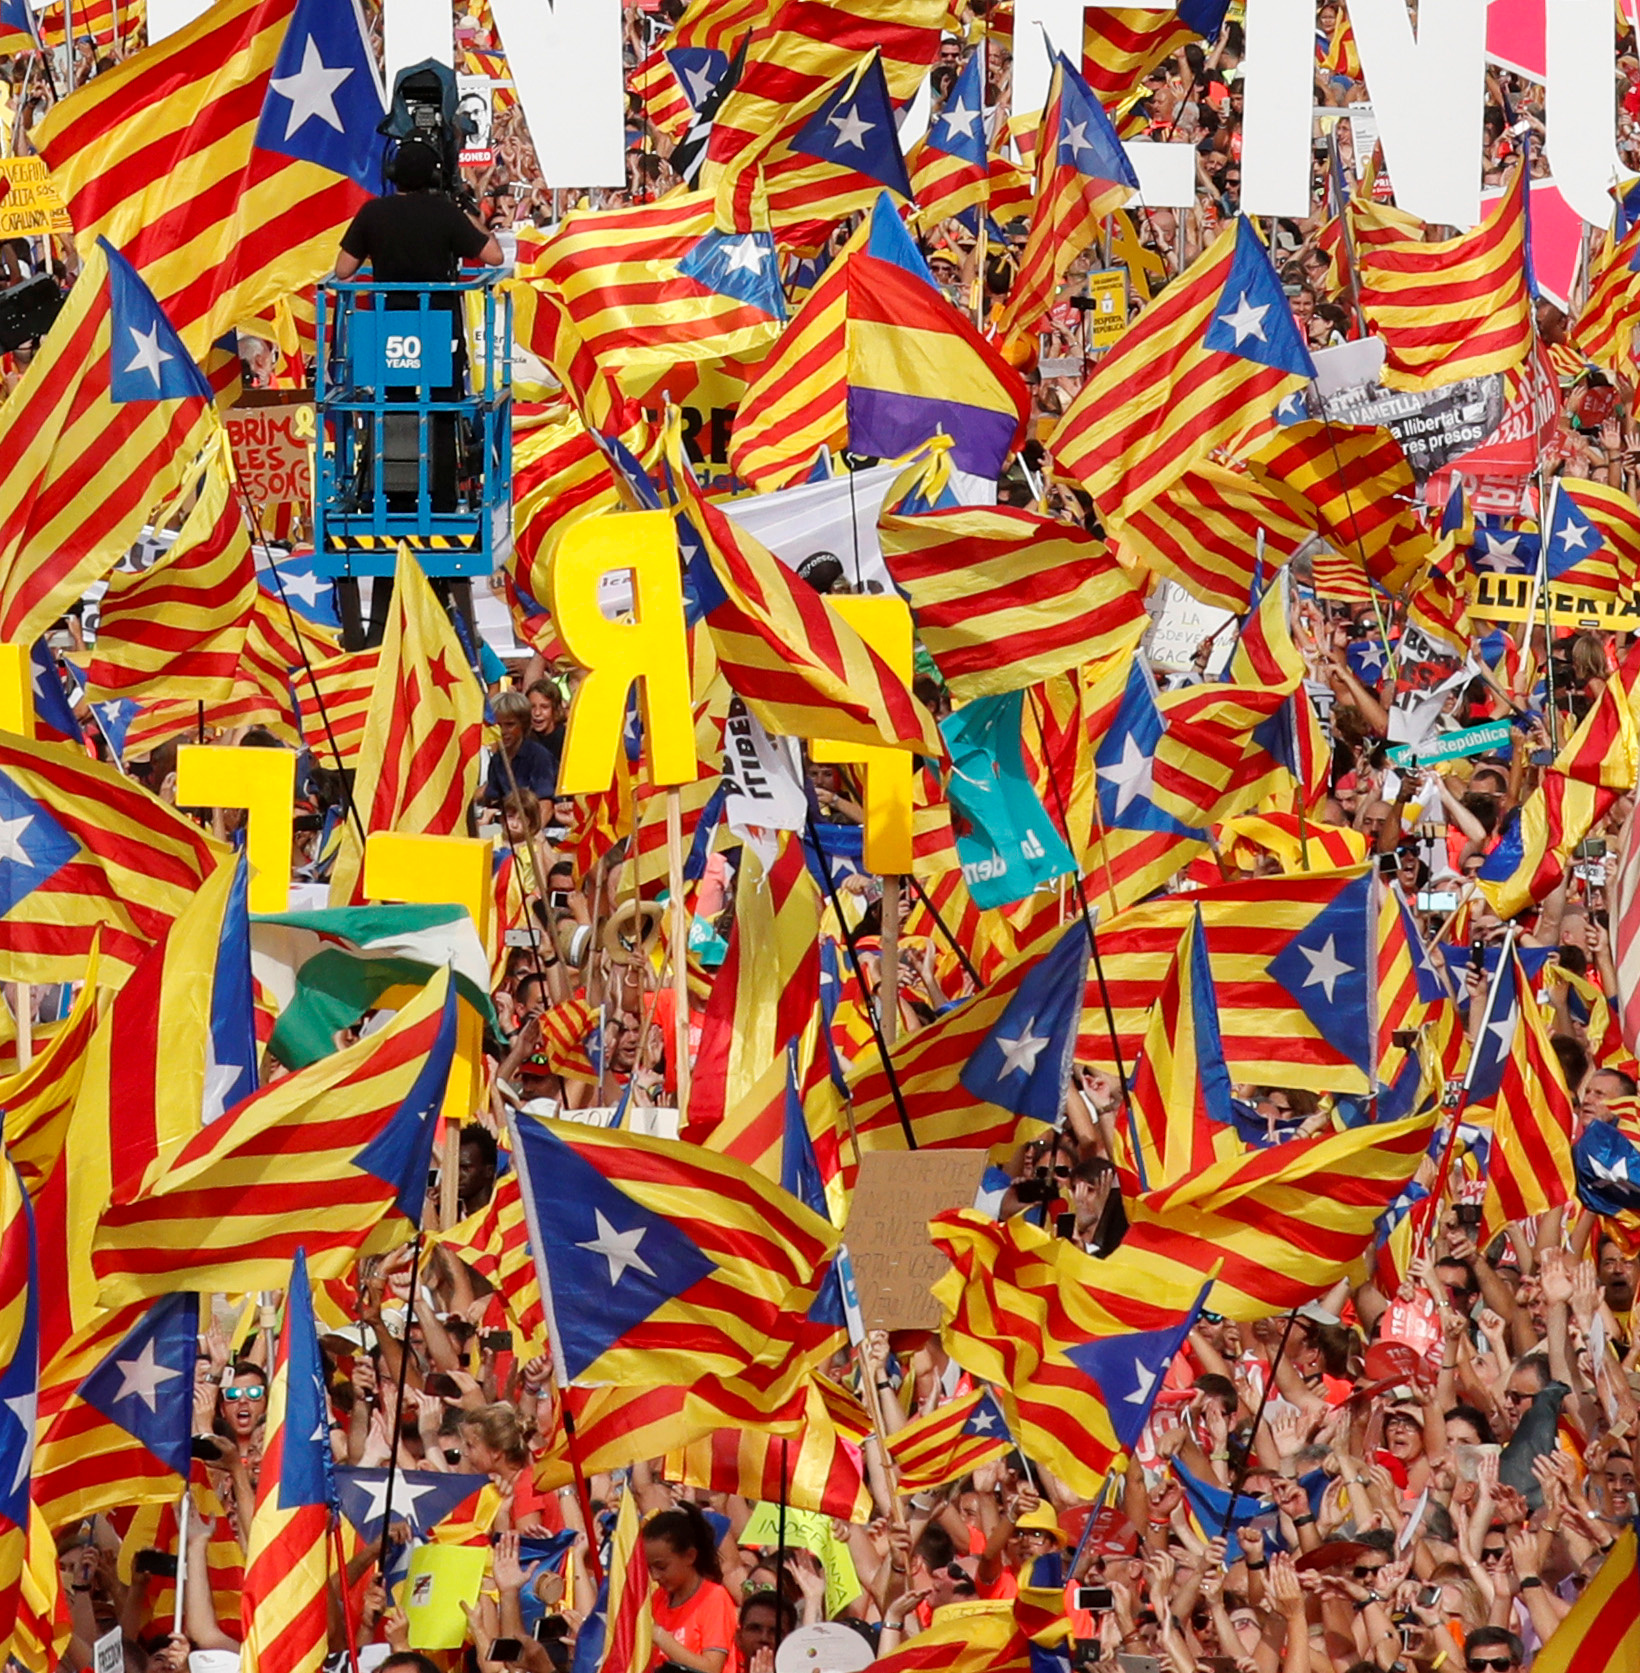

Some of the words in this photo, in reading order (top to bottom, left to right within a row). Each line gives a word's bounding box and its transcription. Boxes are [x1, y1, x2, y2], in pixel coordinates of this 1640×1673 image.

[385, 335, 421, 359] 50
[385, 358, 421, 369] YEARS
[1403, 409, 1461, 437] llibertat
[1429, 423, 1483, 453] presos
